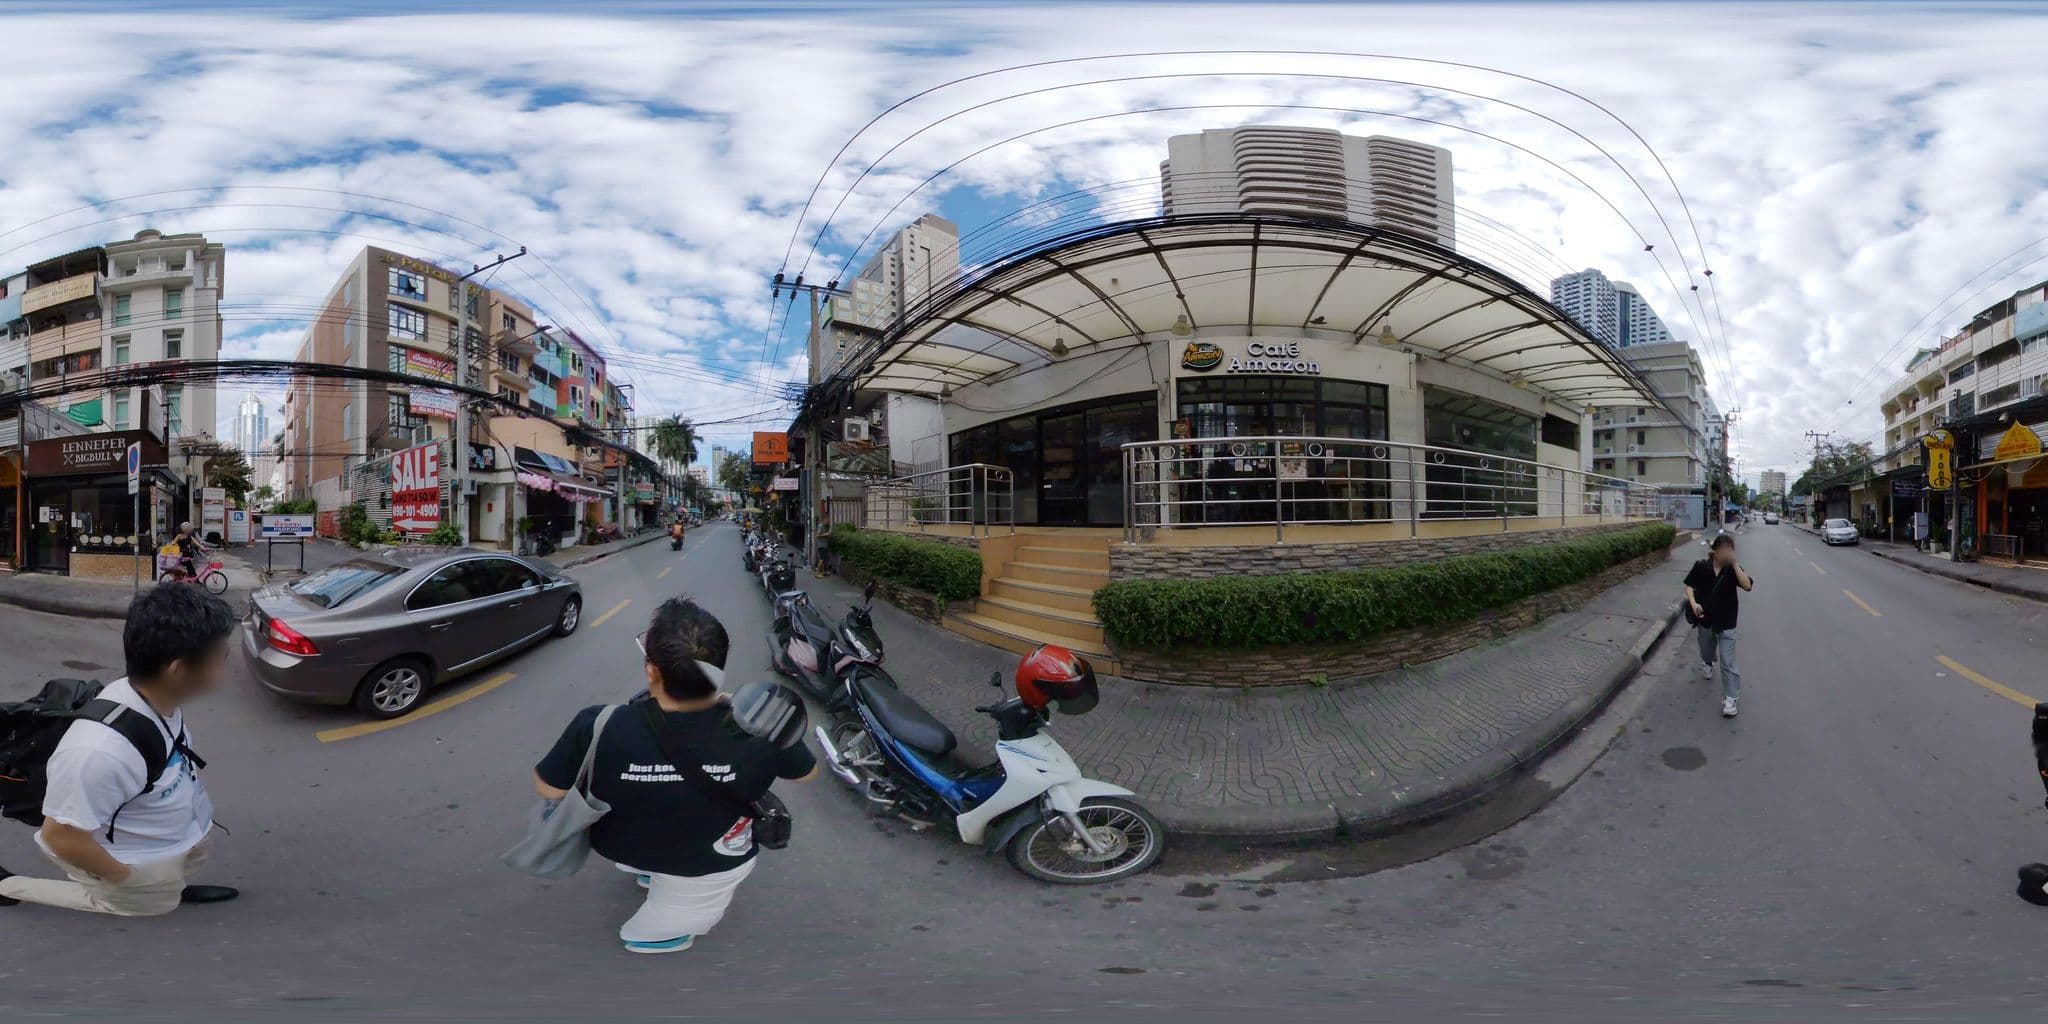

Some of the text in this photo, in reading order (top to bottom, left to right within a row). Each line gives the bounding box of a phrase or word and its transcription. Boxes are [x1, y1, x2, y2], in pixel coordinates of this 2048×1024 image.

[1247, 341, 1300, 358] Café
[1227, 357, 1321, 374] Amazon
[62, 438, 126, 454] LENNEPER
[75, 452, 112, 464] BIGBULL
[392, 444, 439, 493] SALE
